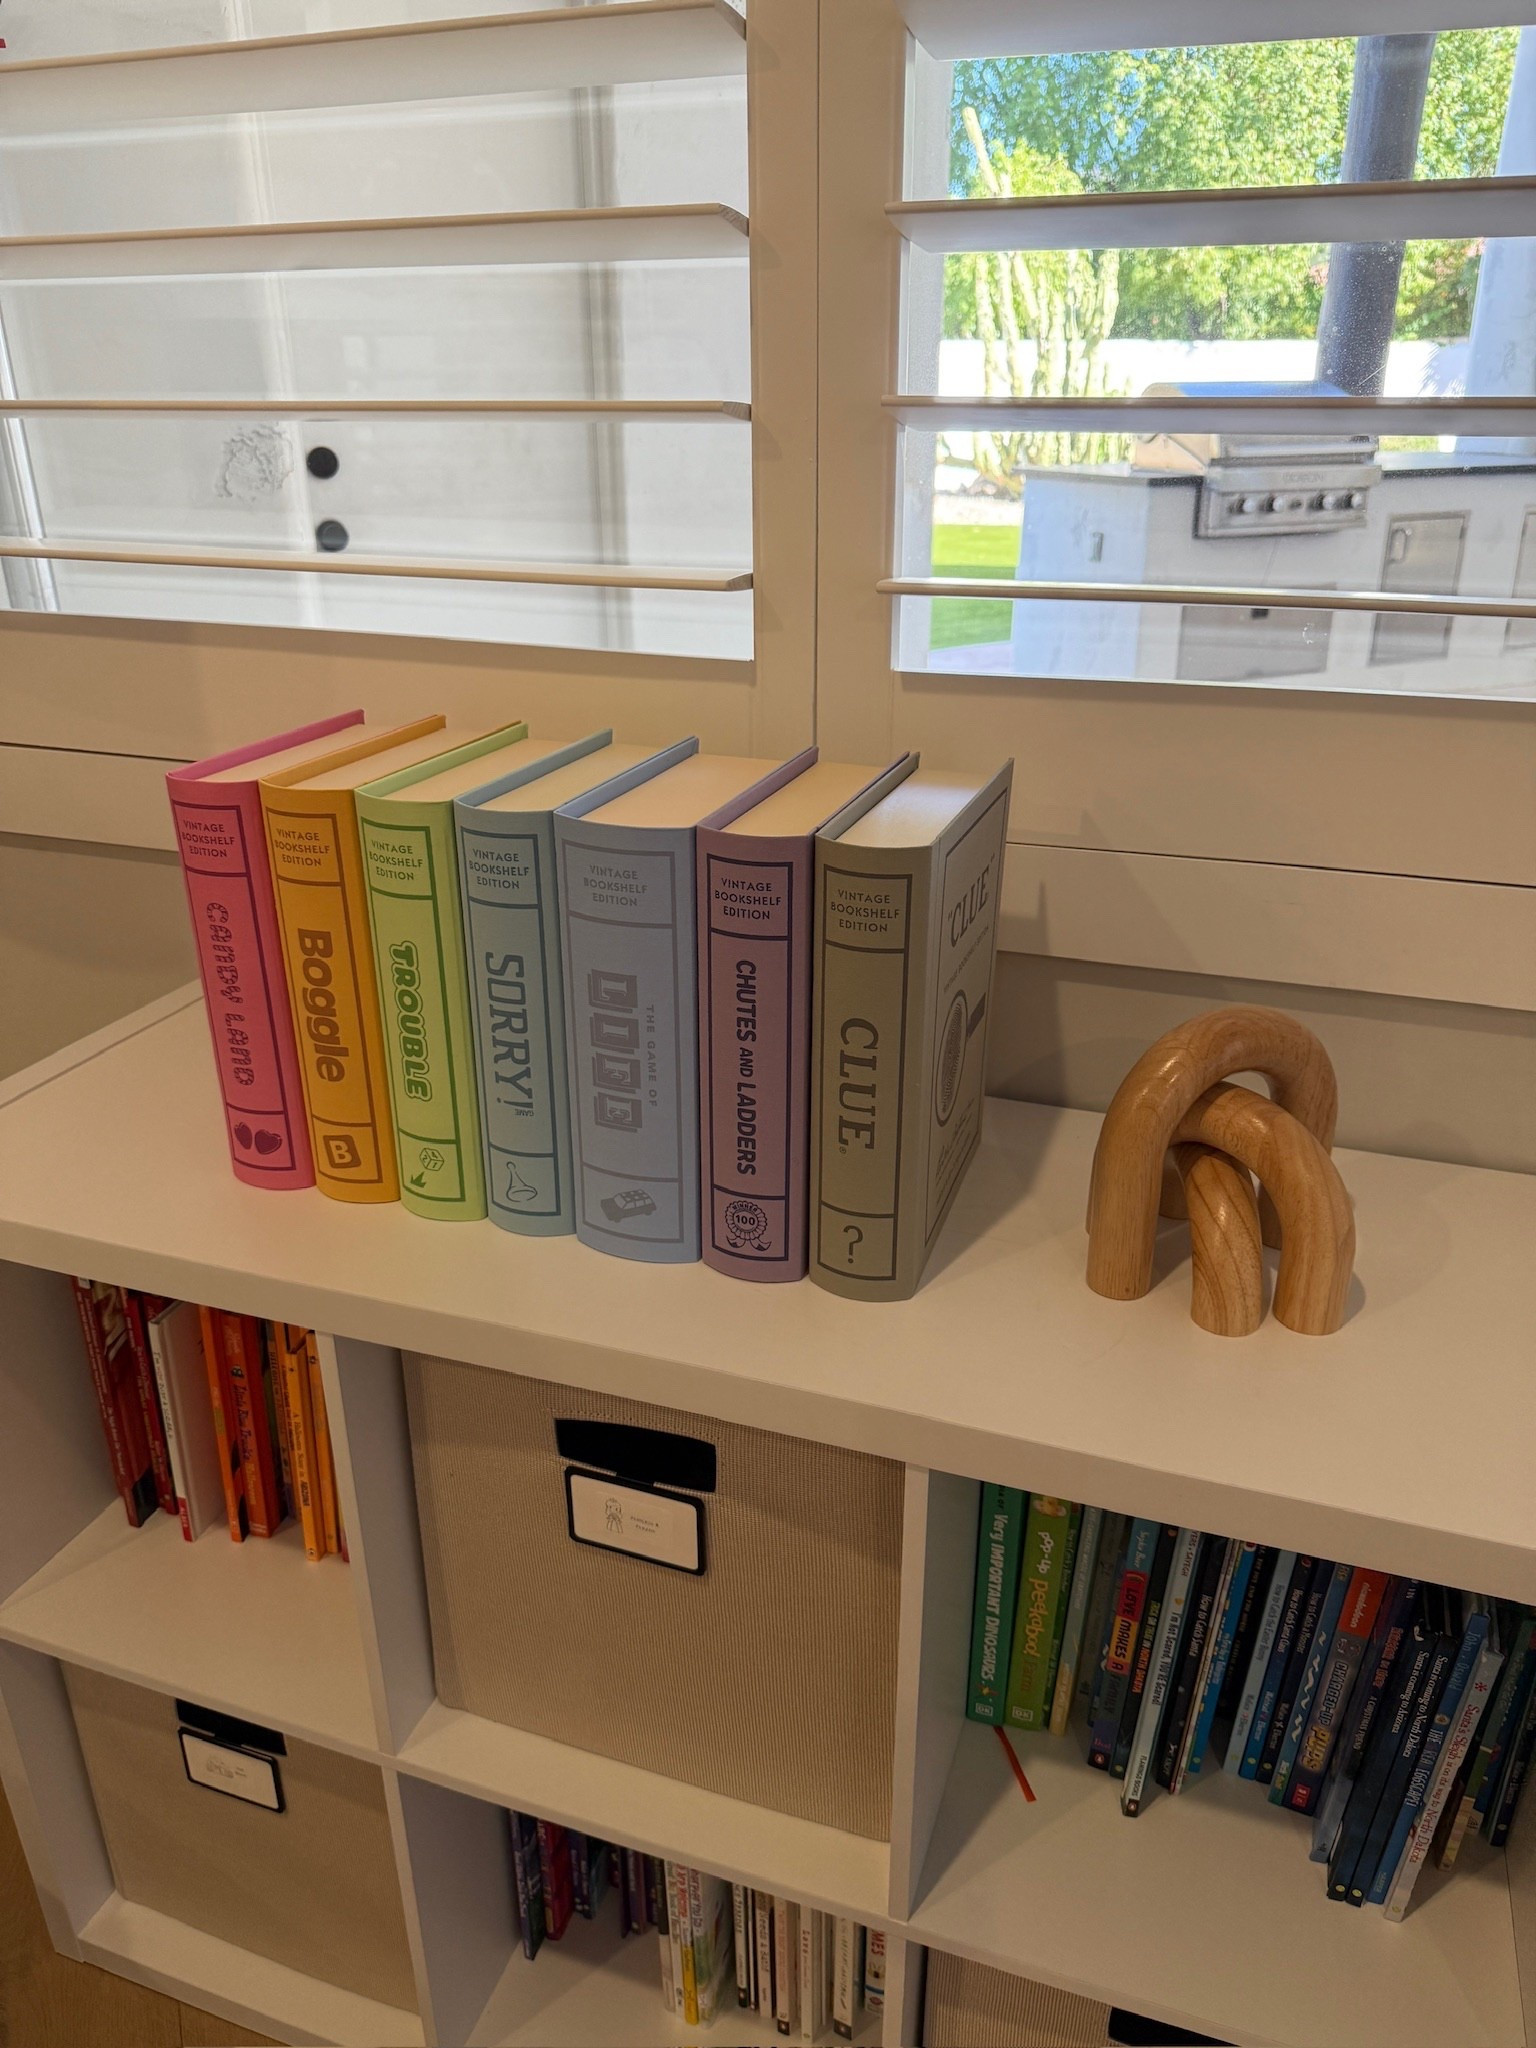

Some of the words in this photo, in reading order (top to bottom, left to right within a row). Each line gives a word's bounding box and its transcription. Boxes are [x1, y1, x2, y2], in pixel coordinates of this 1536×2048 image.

[183, 820, 225, 833] VINTAGE
[276, 828, 320, 841] VINTAGE
[182, 832, 235, 845] BOOKSHELF
[274, 840, 330, 854] BOOKSHELF
[371, 840, 414, 854] VINTAGE
[189, 845, 228, 858] EDITION
[282, 854, 322, 866] EDITION
[369, 851, 423, 868] BOOKSHELF
[472, 849, 520, 862] VINTAGE
[376, 867, 415, 880] EDITION
[469, 861, 529, 876] BOOKSHELF
[589, 865, 638, 879] VINTAGE
[476, 876, 520, 889] EDITION
[584, 877, 648, 894] BOOKSHELF
[721, 878, 772, 892] VINTAGE
[592, 893, 638, 906] EDITION
[714, 890, 781, 906] BOOKSHELF
[837, 889, 891, 904] VINTAGE
[723, 906, 770, 920] EDITION
[830, 902, 900, 919] BOOKSHELF
[839, 919, 888, 932] EDITION
[297, 928, 349, 1082] Boggle
[736, 960, 757, 1042] CHUTES
[391, 940, 432, 1102] TROUBLE
[646, 1004, 655, 1033] THE
[486, 952, 534, 1109] SORRY!
[592, 969, 643, 1130] LIFE
[647, 1041, 657, 1082] GAME
[739, 1047, 753, 1078] AND
[649, 1090, 658, 1107] OF
[737, 1082, 756, 1176] LADDERS
[329, 1140, 352, 1162] B
[736, 1214, 755, 1226] 100
[988, 1513, 1008, 1541] Very
[1032, 1530, 1056, 1574] pop-up
[1180, 1550, 1193, 1577] SAYEGH
[984, 1542, 1005, 1613] IMPORTANT
[1121, 1587, 1139, 1616] LOVE
[1198, 1593, 1212, 1610] How
[1290, 1587, 1303, 1602] How
[1308, 1591, 1322, 1606] How
[1196, 1609, 1207, 1619] to
[1348, 1581, 1371, 1629] nickelodeon
[1018, 1577, 1052, 1657] peekaboo!
[1169, 1611, 1182, 1623] I'm
[1283, 1607, 1298, 1625] Catch
[1302, 1611, 1316, 1628] Catch
[1166, 1622, 1179, 1636] Not
[1191, 1618, 1206, 1639] Catch
[1279, 1623, 1294, 1640] Santa
[980, 1615, 999, 1680] DINOSAURS
[1113, 1619, 1132, 1659] MAKES
[1160, 1635, 1176, 1661] Scared,
[1186, 1636, 1201, 1657] Santa
[1111, 1661, 1124, 1671] A
[1135, 1646, 1150, 1669] NORTH
[1411, 1649, 1428, 1670] Santa
[1430, 1653, 1447, 1676] Santa
[1130, 1668, 1145, 1694] DAKOTA
[1409, 1668, 1421, 1677] is
[1428, 1673, 1439, 1681] is
[1150, 1680, 1166, 1706] Scared!
[1316, 1659, 1349, 1727] CHARGED-UP
[1399, 1673, 1418, 1701] coming
[1416, 1678, 1436, 1706] coming
[1398, 1699, 1409, 1709] to
[1417, 1704, 1428, 1713] to
[1389, 1706, 1409, 1735] Arizona
[1409, 1711, 1427, 1735] North
[1457, 1702, 1480, 1736] Santa's
[1400, 1732, 1419, 1759] Dakota
[1425, 1727, 1444, 1746] THE
[1298, 1724, 1332, 1772] PUPS
[1446, 1733, 1468, 1762] Sleigh
[1134, 1754, 1148, 1780] FLAMINGO
[1442, 1765, 1452, 1777] on
[1130, 1779, 1142, 1797] BOOKS
[1402, 1767, 1429, 1808] EGGSCAPE!
[1438, 1775, 1449, 1787] its
[1431, 1785, 1444, 1801] way
[1429, 1798, 1440, 1808] to
[1419, 1807, 1438, 1836] North
[1407, 1833, 1429, 1865] Dakota
